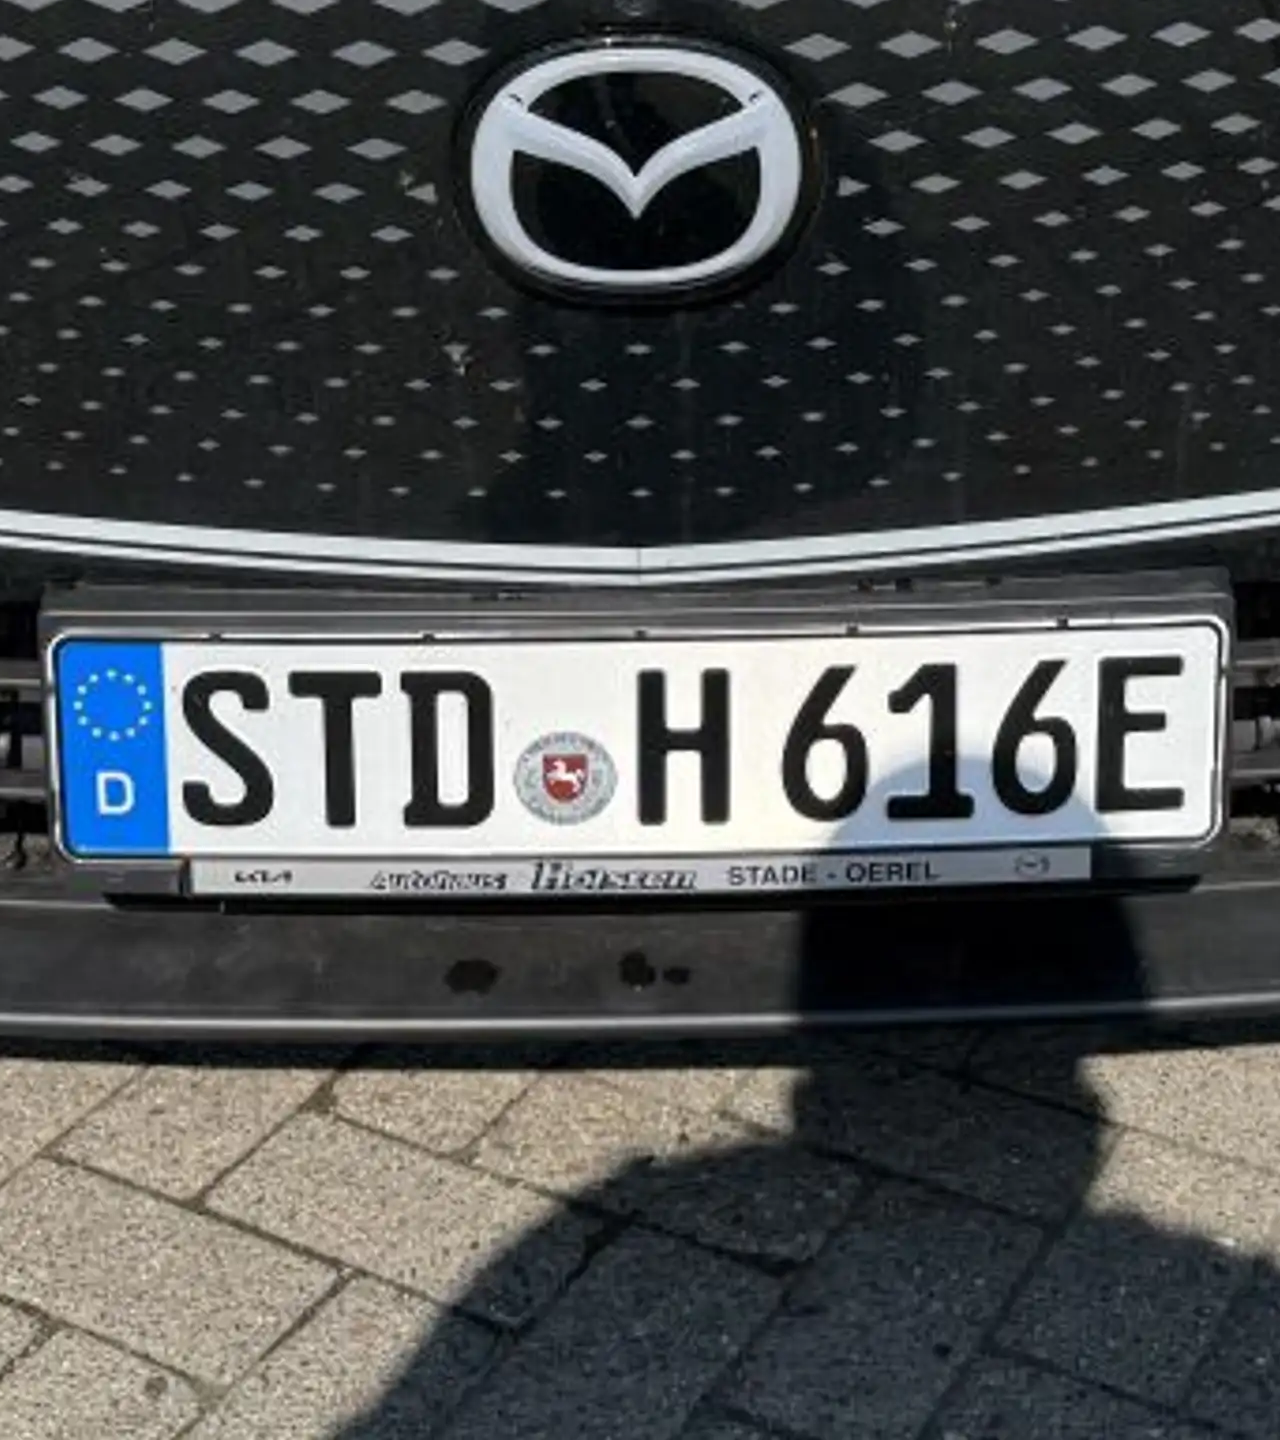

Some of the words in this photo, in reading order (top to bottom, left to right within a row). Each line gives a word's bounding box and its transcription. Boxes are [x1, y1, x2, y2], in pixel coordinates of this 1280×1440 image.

[182, 670, 495, 828] STD
[637, 668, 731, 826] H
[781, 654, 1184, 822] 616E
[96, 770, 135, 816] D
[727, 865, 818, 886] STADE
[845, 861, 941, 883] OEREL
